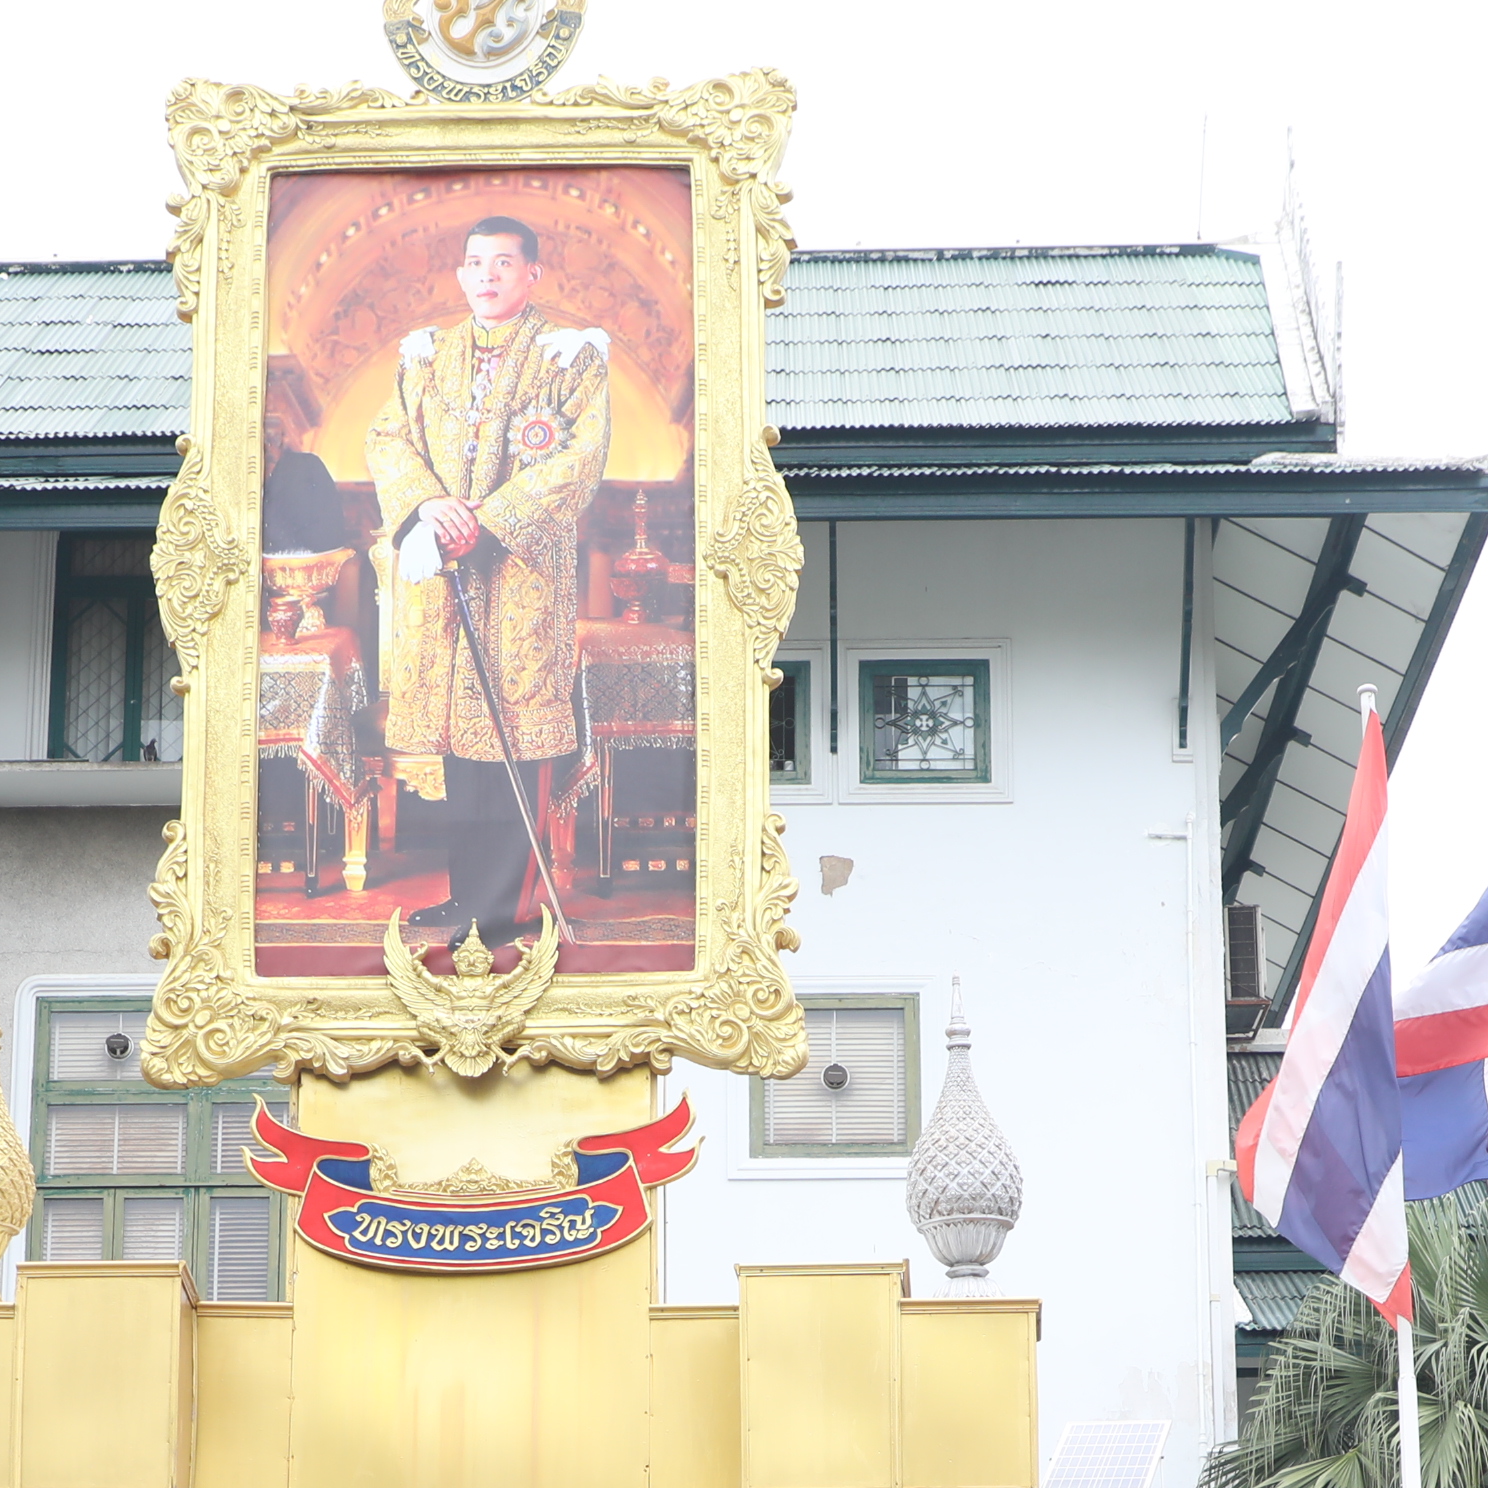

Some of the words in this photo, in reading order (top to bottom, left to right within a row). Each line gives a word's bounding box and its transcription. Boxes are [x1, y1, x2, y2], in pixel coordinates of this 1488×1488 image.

[396, 40, 567, 103] ทรงพระเจริญ
[352, 1207, 595, 1251] ทรงพระเจริญ
